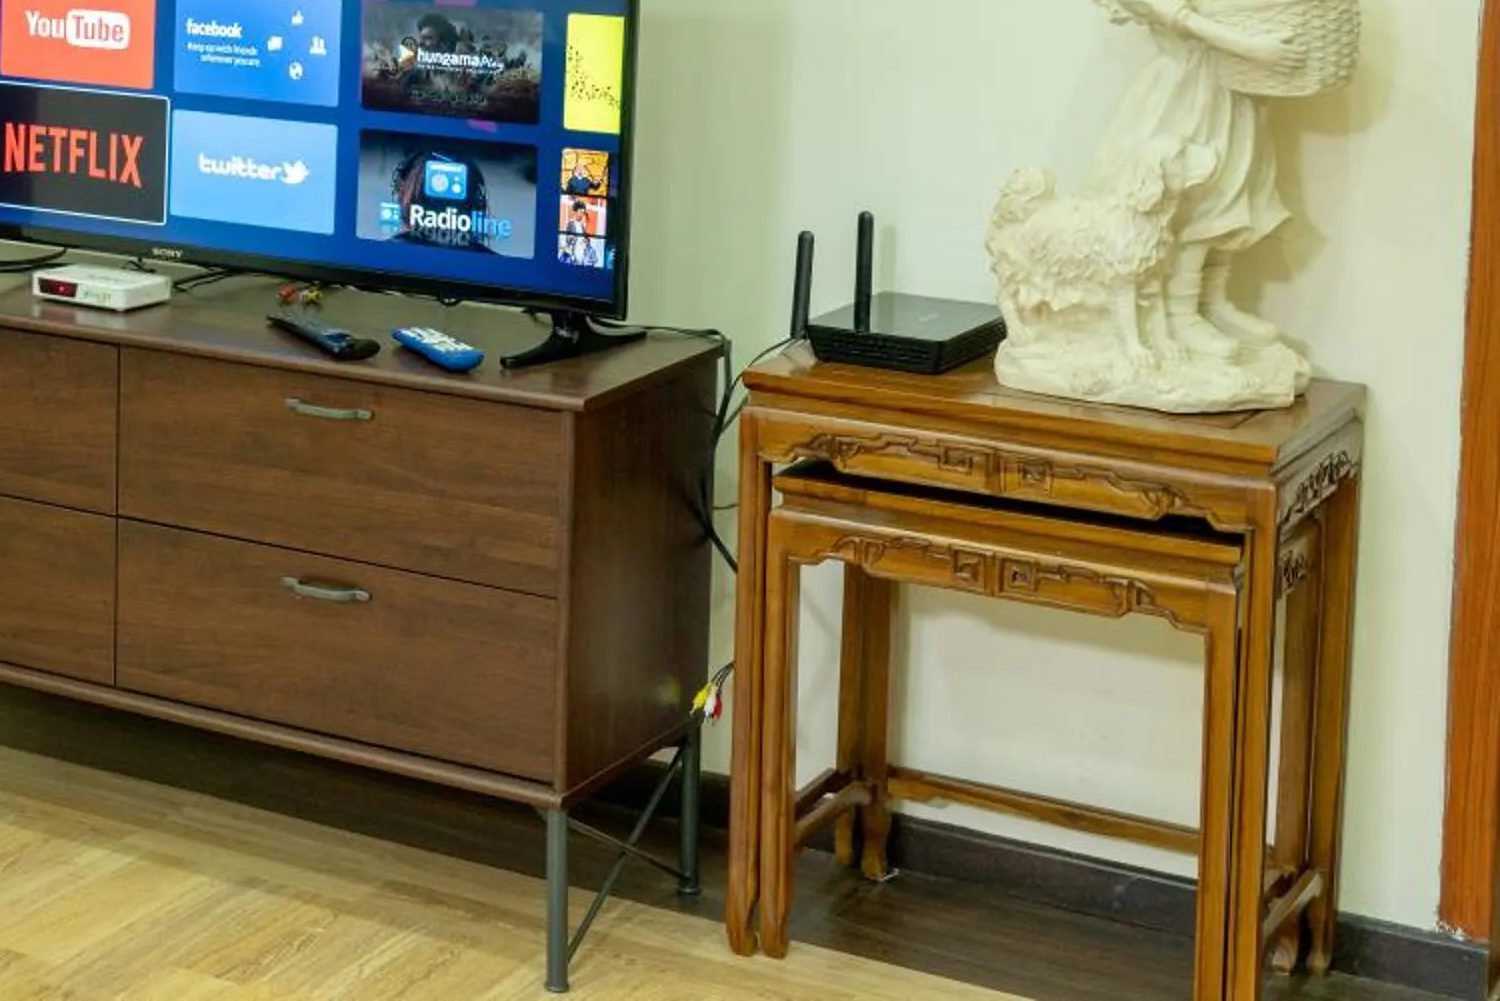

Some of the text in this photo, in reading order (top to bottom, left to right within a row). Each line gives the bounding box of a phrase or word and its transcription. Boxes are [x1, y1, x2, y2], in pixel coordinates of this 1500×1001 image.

[26, 10, 127, 44] YouTube
[186, 18, 243, 38] facebook
[3, 122, 145, 189] NETFLIX
[197, 152, 281, 182] twitter
[409, 203, 513, 238] Radioline
[151, 246, 183, 258] SONY
